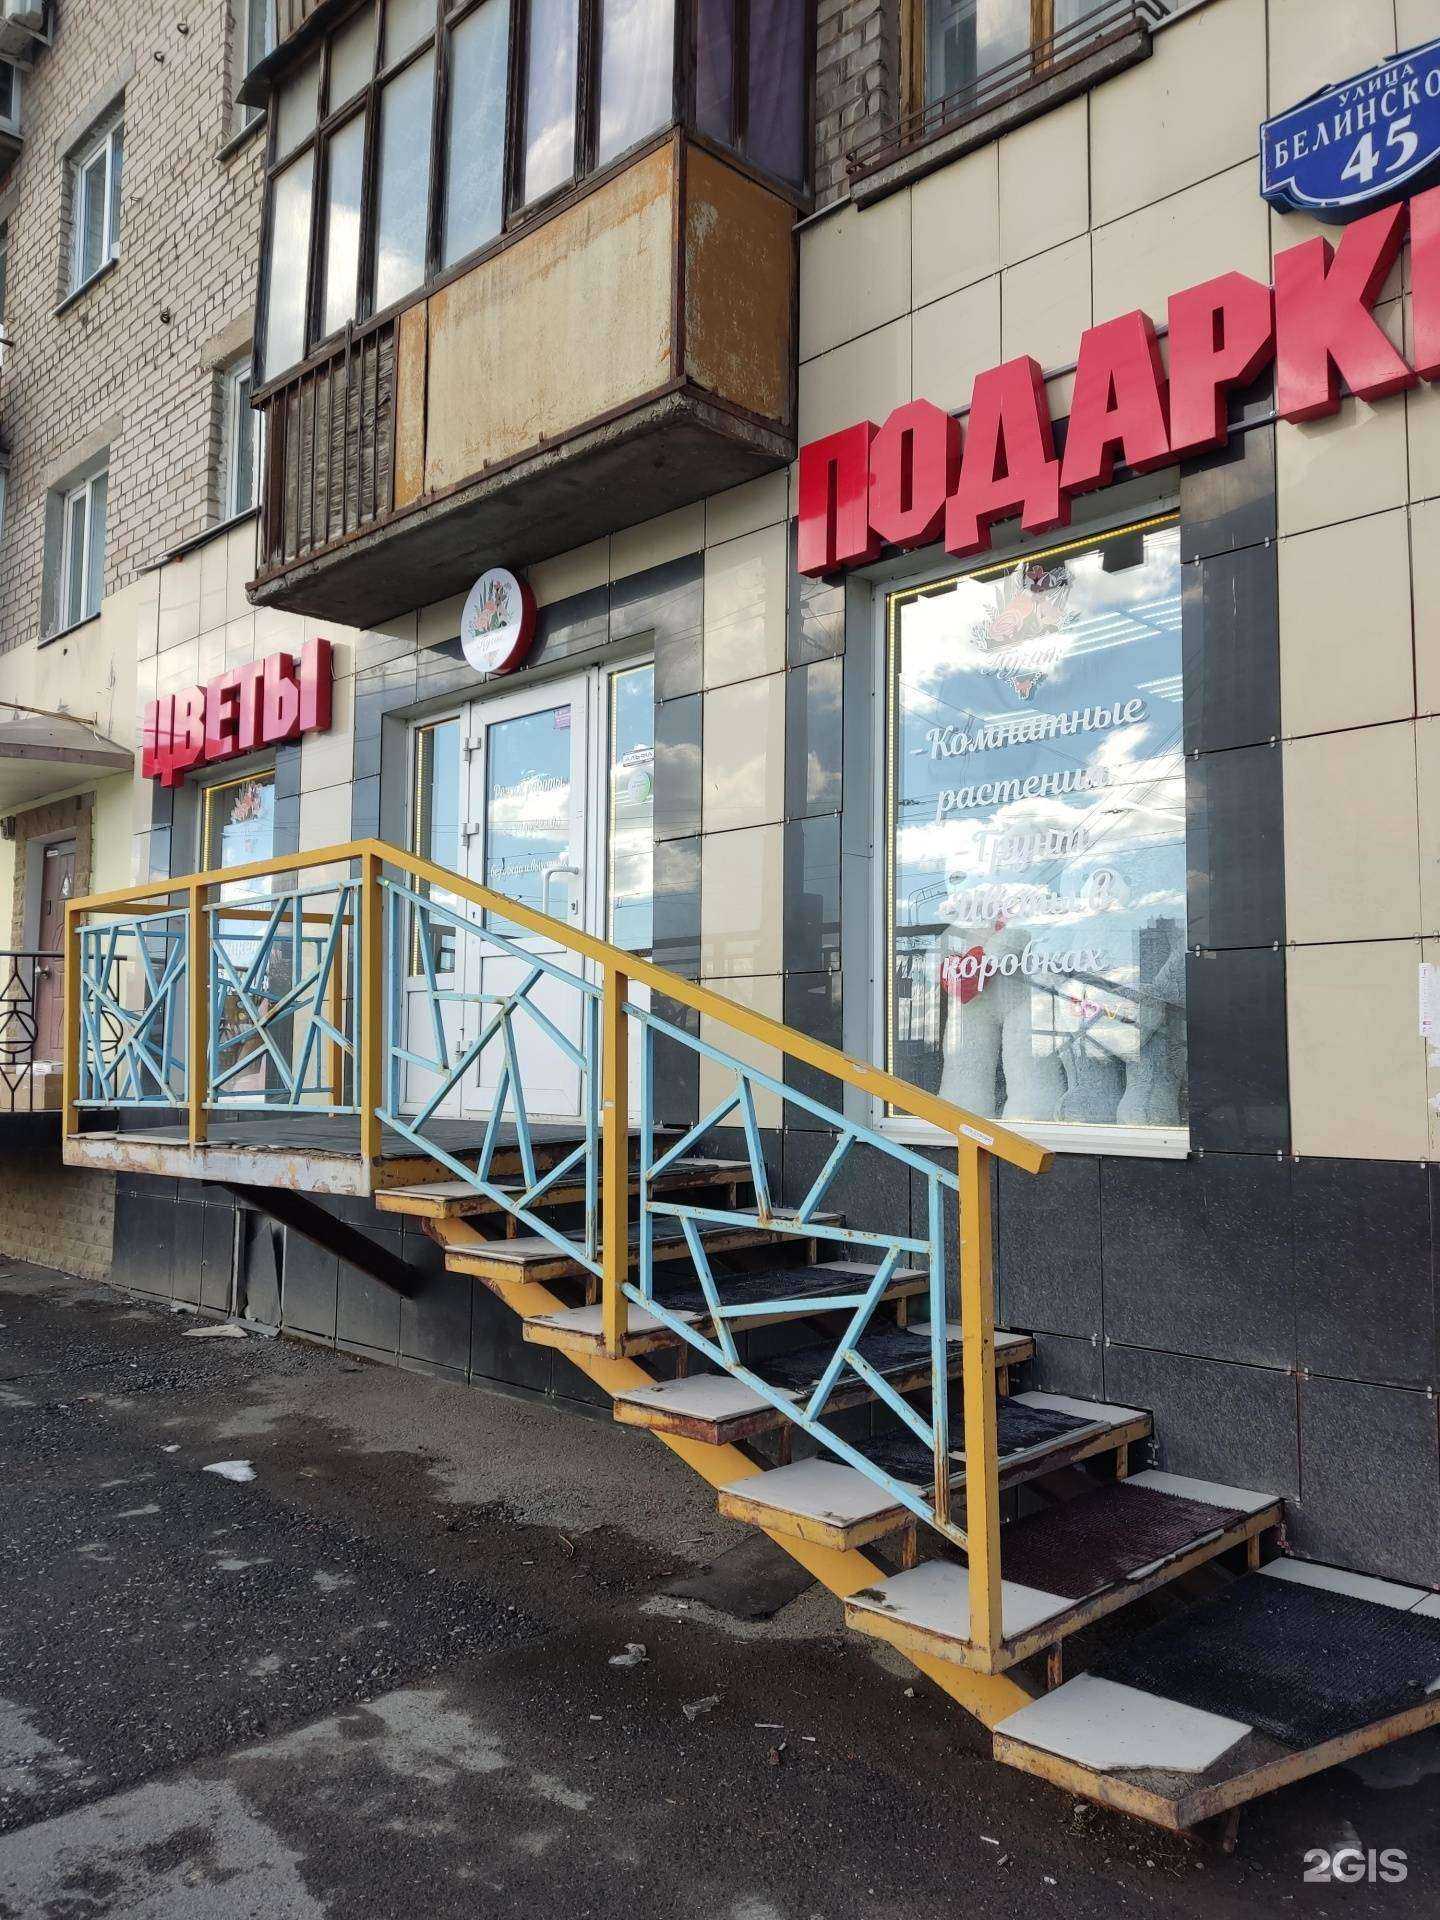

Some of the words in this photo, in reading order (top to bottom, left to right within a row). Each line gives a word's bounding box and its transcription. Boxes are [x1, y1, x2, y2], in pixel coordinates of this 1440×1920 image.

[1339, 63, 1415, 107] УЛИЦА
[1340, 114, 1418, 183] 45
[142, 636, 333, 788] ЦВЕТЫ
[942, 938, 1108, 993] коробках
